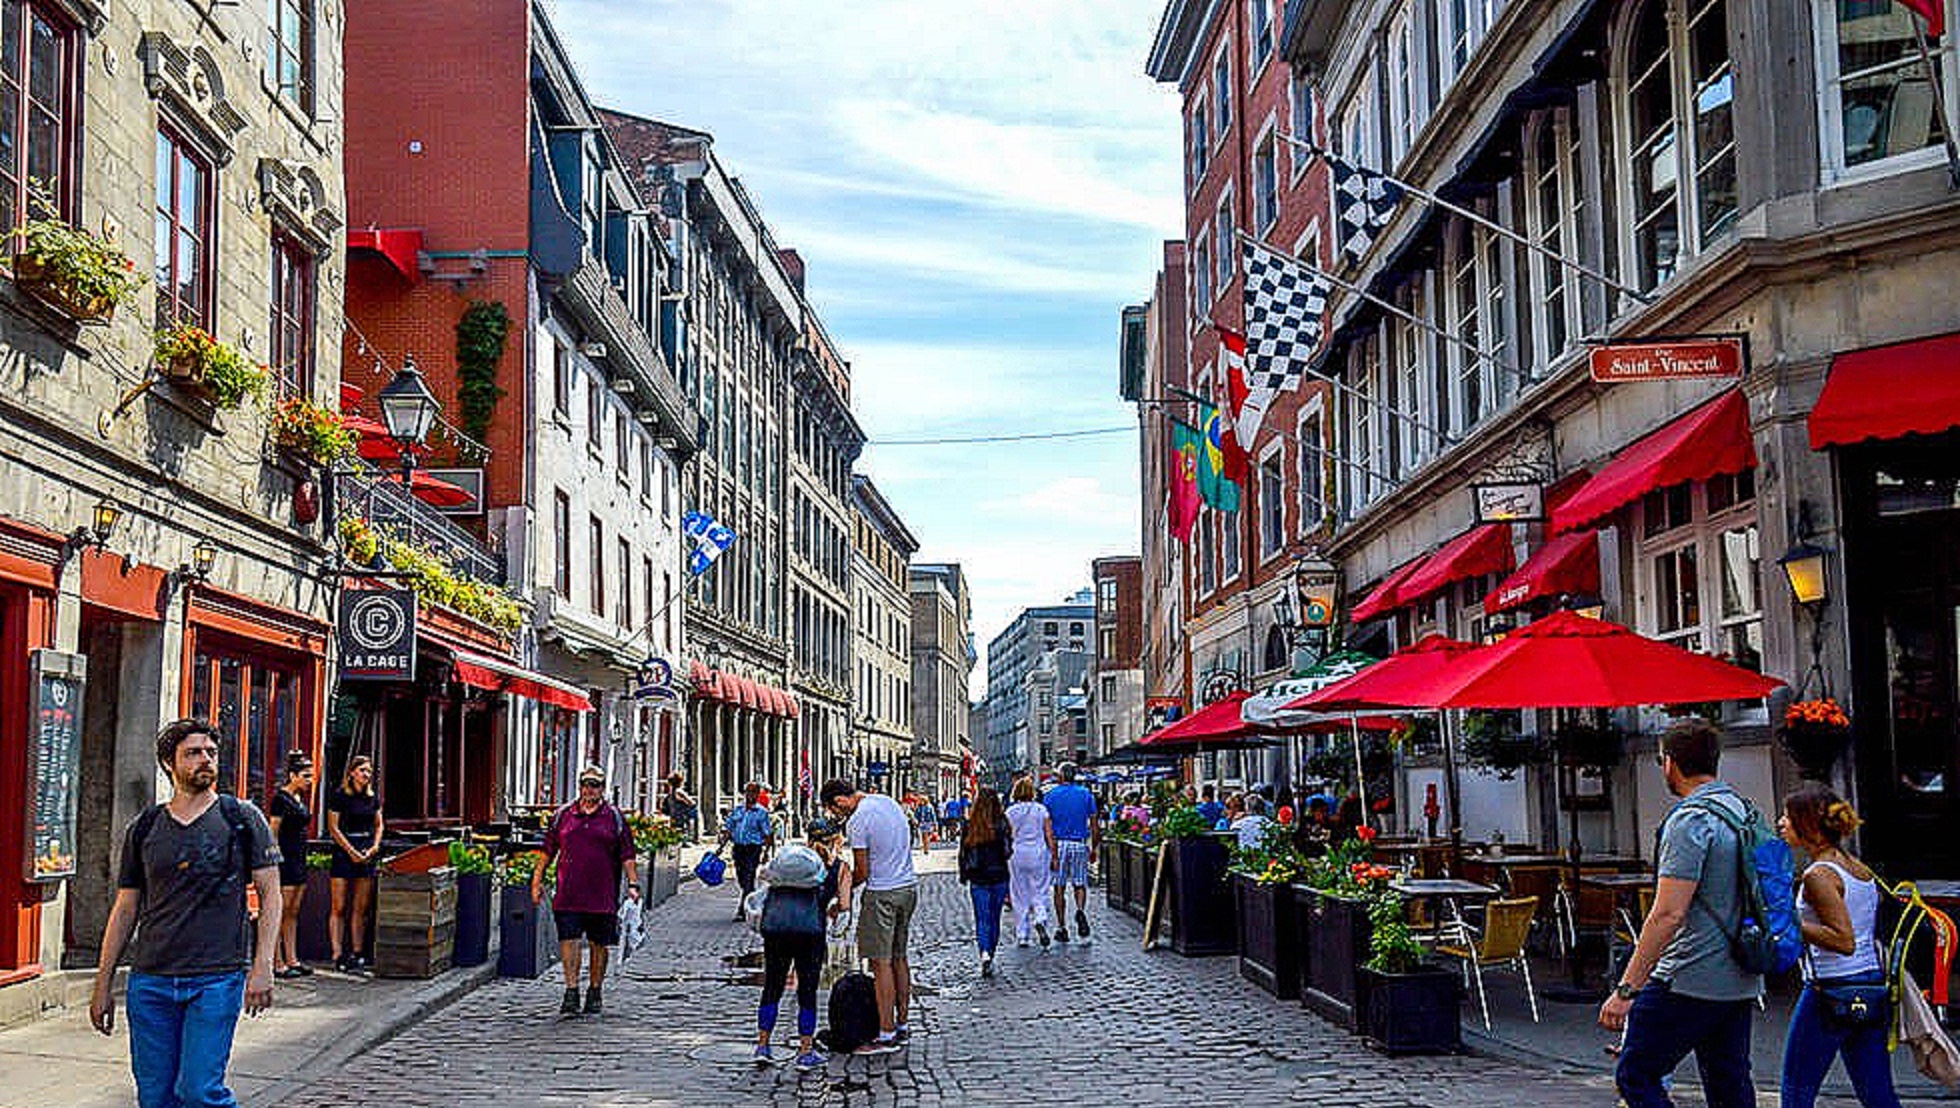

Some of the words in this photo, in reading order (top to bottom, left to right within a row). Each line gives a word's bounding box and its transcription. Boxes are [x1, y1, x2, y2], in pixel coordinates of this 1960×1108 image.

[1611, 355, 1719, 375] Saint-Vincent
[344, 655, 363, 667] LA
[367, 655, 409, 668] CAGE
